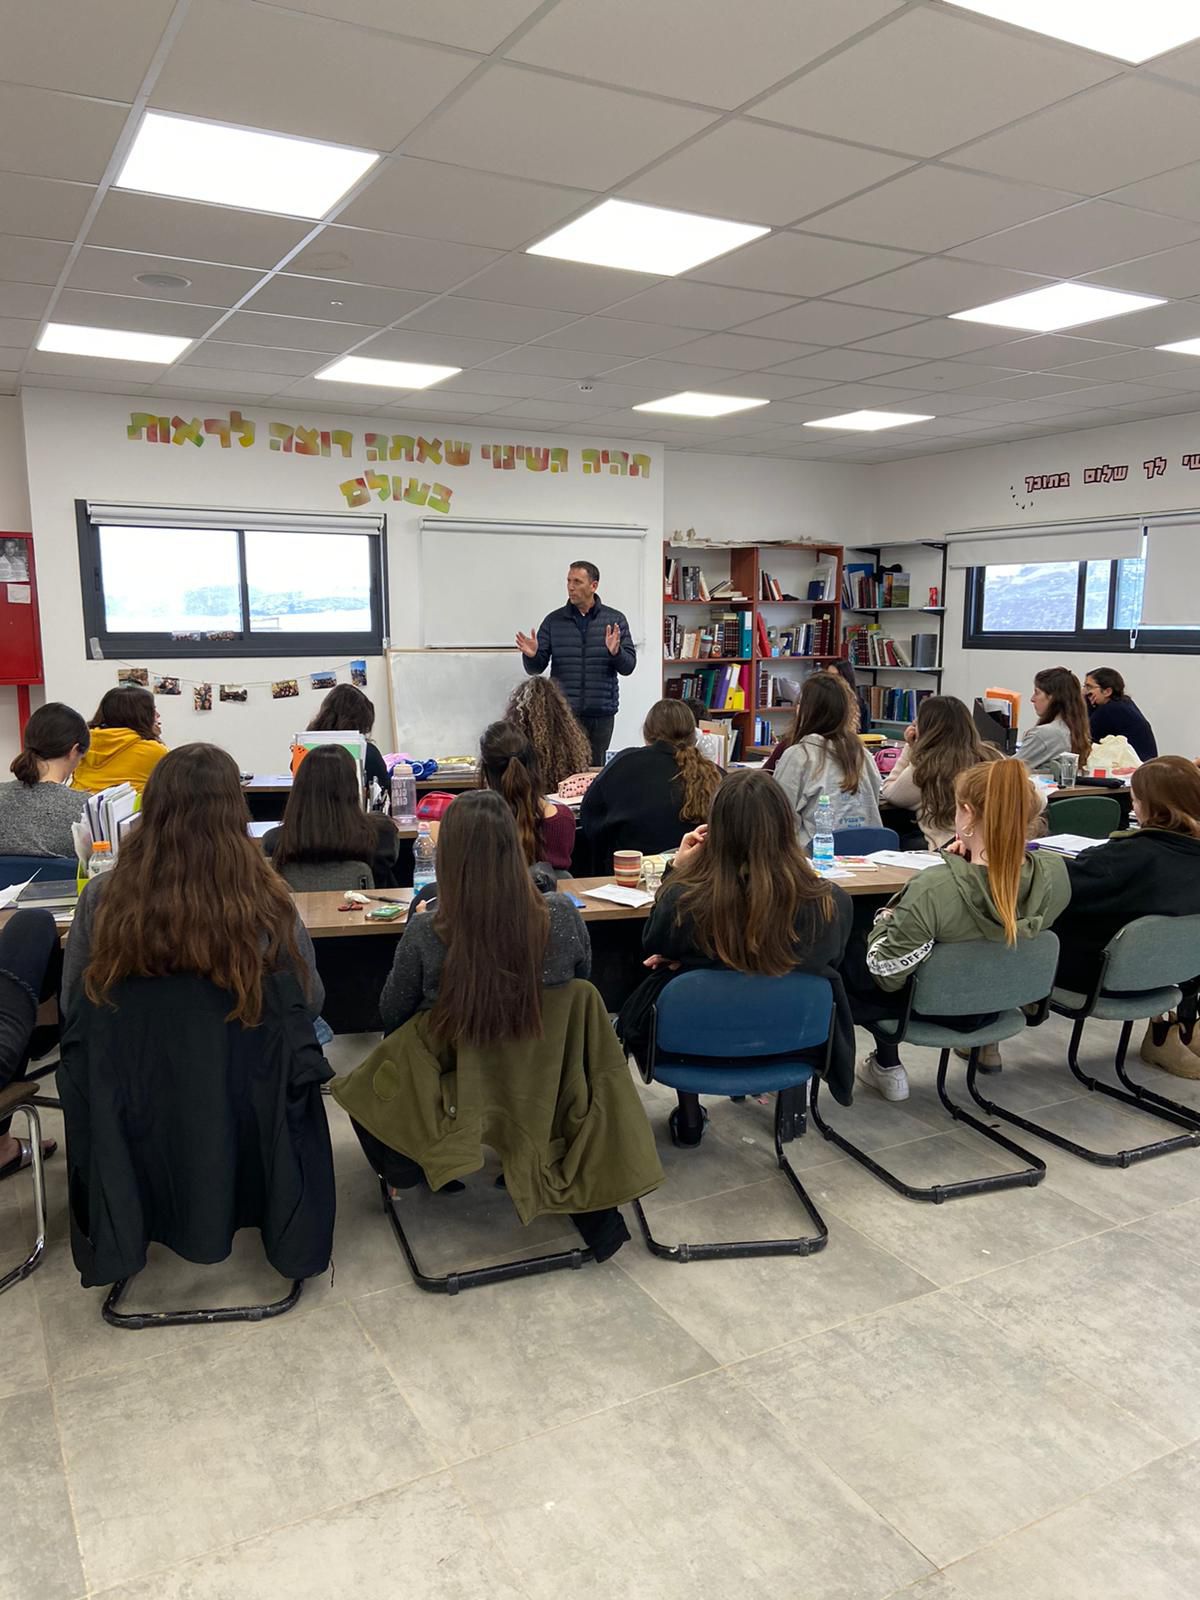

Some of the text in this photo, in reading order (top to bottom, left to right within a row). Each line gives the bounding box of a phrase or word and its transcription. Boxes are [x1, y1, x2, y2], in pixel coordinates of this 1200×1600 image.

[128, 411, 651, 478] תהיה השינוי שאתה רוצה לראות
[1084, 464, 1128, 484] שלום
[1143, 457, 1167, 479] לך
[339, 469, 453, 514] בעולם
[1025, 472, 1070, 493] בתוכך
